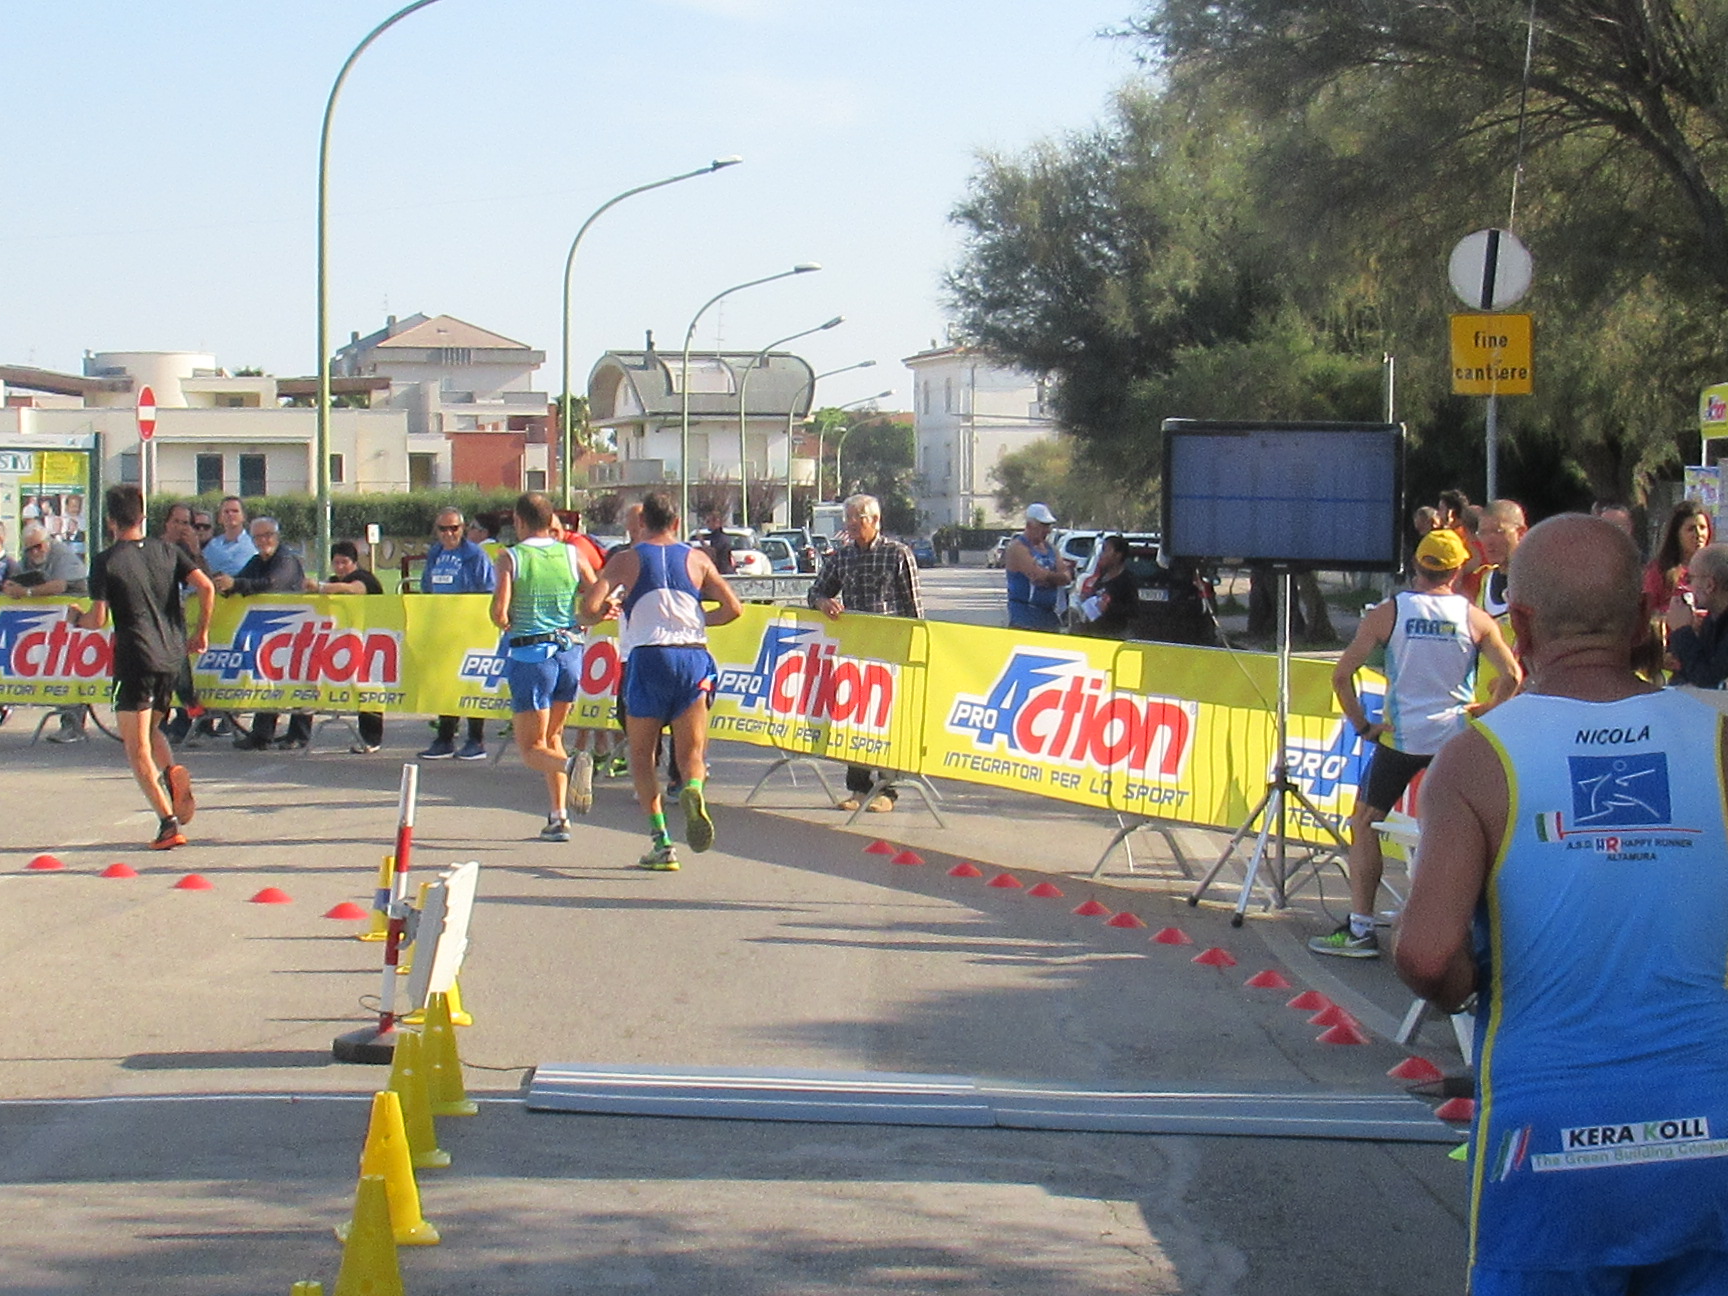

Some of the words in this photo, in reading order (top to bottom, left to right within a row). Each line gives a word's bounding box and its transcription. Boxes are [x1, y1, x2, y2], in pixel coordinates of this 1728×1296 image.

[1474, 331, 1508, 348] fine
[1455, 364, 1528, 380] cantiere
[200, 653, 243, 668] PRO
[222, 609, 397, 683] Action
[464, 657, 506, 676] PRO
[720, 675, 762, 694] PRO
[741, 625, 893, 728] Action
[43, 685, 69, 696] PER
[78, 686, 96, 697] LO
[198, 689, 284, 700] NTEGRATORI
[291, 690, 319, 702] PER
[329, 691, 350, 702] LO
[359, 691, 407, 703] SPORT
[953, 704, 999, 729] PRO
[977, 653, 1189, 775] Action
[710, 716, 789, 738] INTEGRATORI
[795, 728, 822, 744] PER
[827, 732, 843, 747] LO
[849, 736, 891, 755] SPORT
[1575, 725, 1651, 745] NICOLA
[943, 751, 1042, 782] INTEGRATORI
[1050, 772, 1081, 790] PER
[1089, 778, 1112, 796] LO
[1123, 783, 1190, 807] SPORT
[1596, 837, 1619, 853] HR
[1622, 838, 1652, 848] HAPPY
[1655, 838, 1692, 848] RUNNER
[1607, 852, 1656, 862] ALTAMURA
[1569, 1125, 1634, 1148] KERA
[1643, 1119, 1705, 1142] KOLL
[1535, 1154, 1560, 1168] The
[1565, 1150, 1610, 1165] Green
[1615, 1146, 1673, 1163] Building
